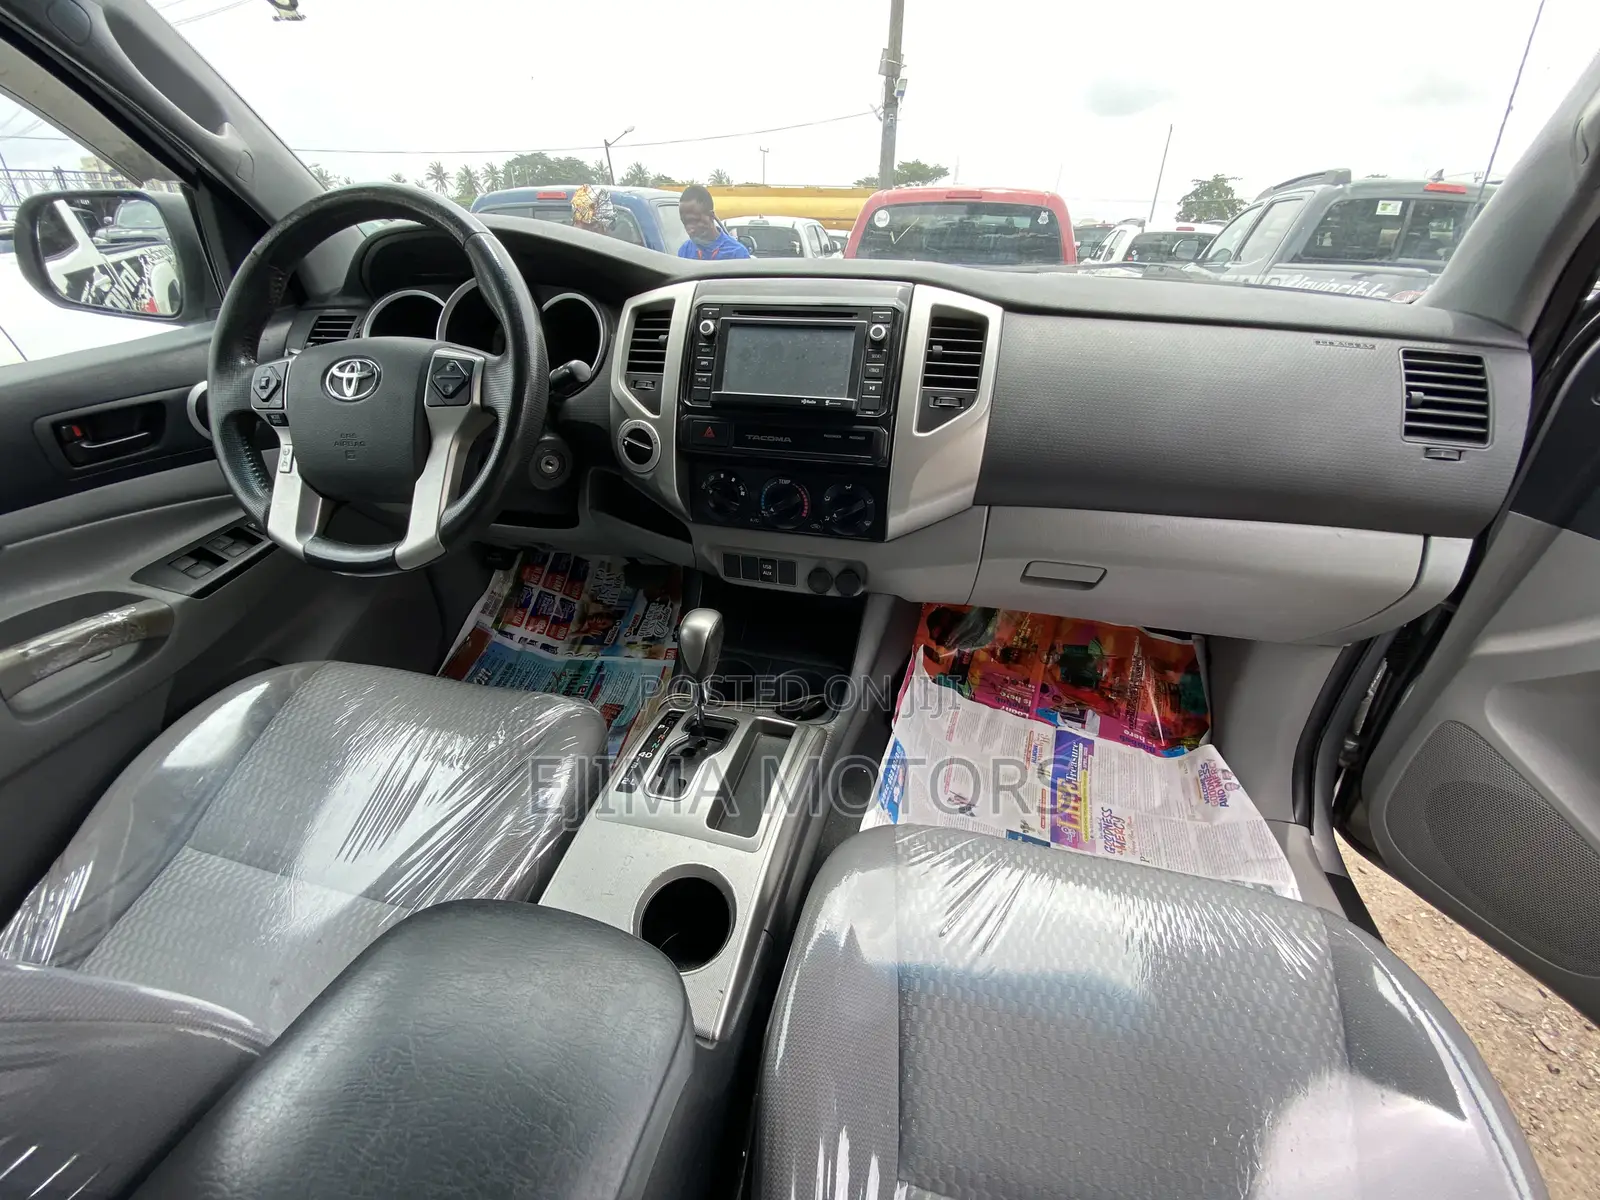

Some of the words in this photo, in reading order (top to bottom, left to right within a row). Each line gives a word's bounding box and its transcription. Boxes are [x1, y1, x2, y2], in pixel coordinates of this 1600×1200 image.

[745, 434, 792, 443] TACOMA
[1065, 741, 1080, 782] Treasure
[1207, 759, 1223, 789] MERCY
[1057, 777, 1081, 829] LIFE
[1201, 762, 1219, 807] GOODNESS
[1217, 788, 1229, 807] AND
[1102, 807, 1115, 854] GOODNESS
[1113, 815, 1127, 851] MERCY
